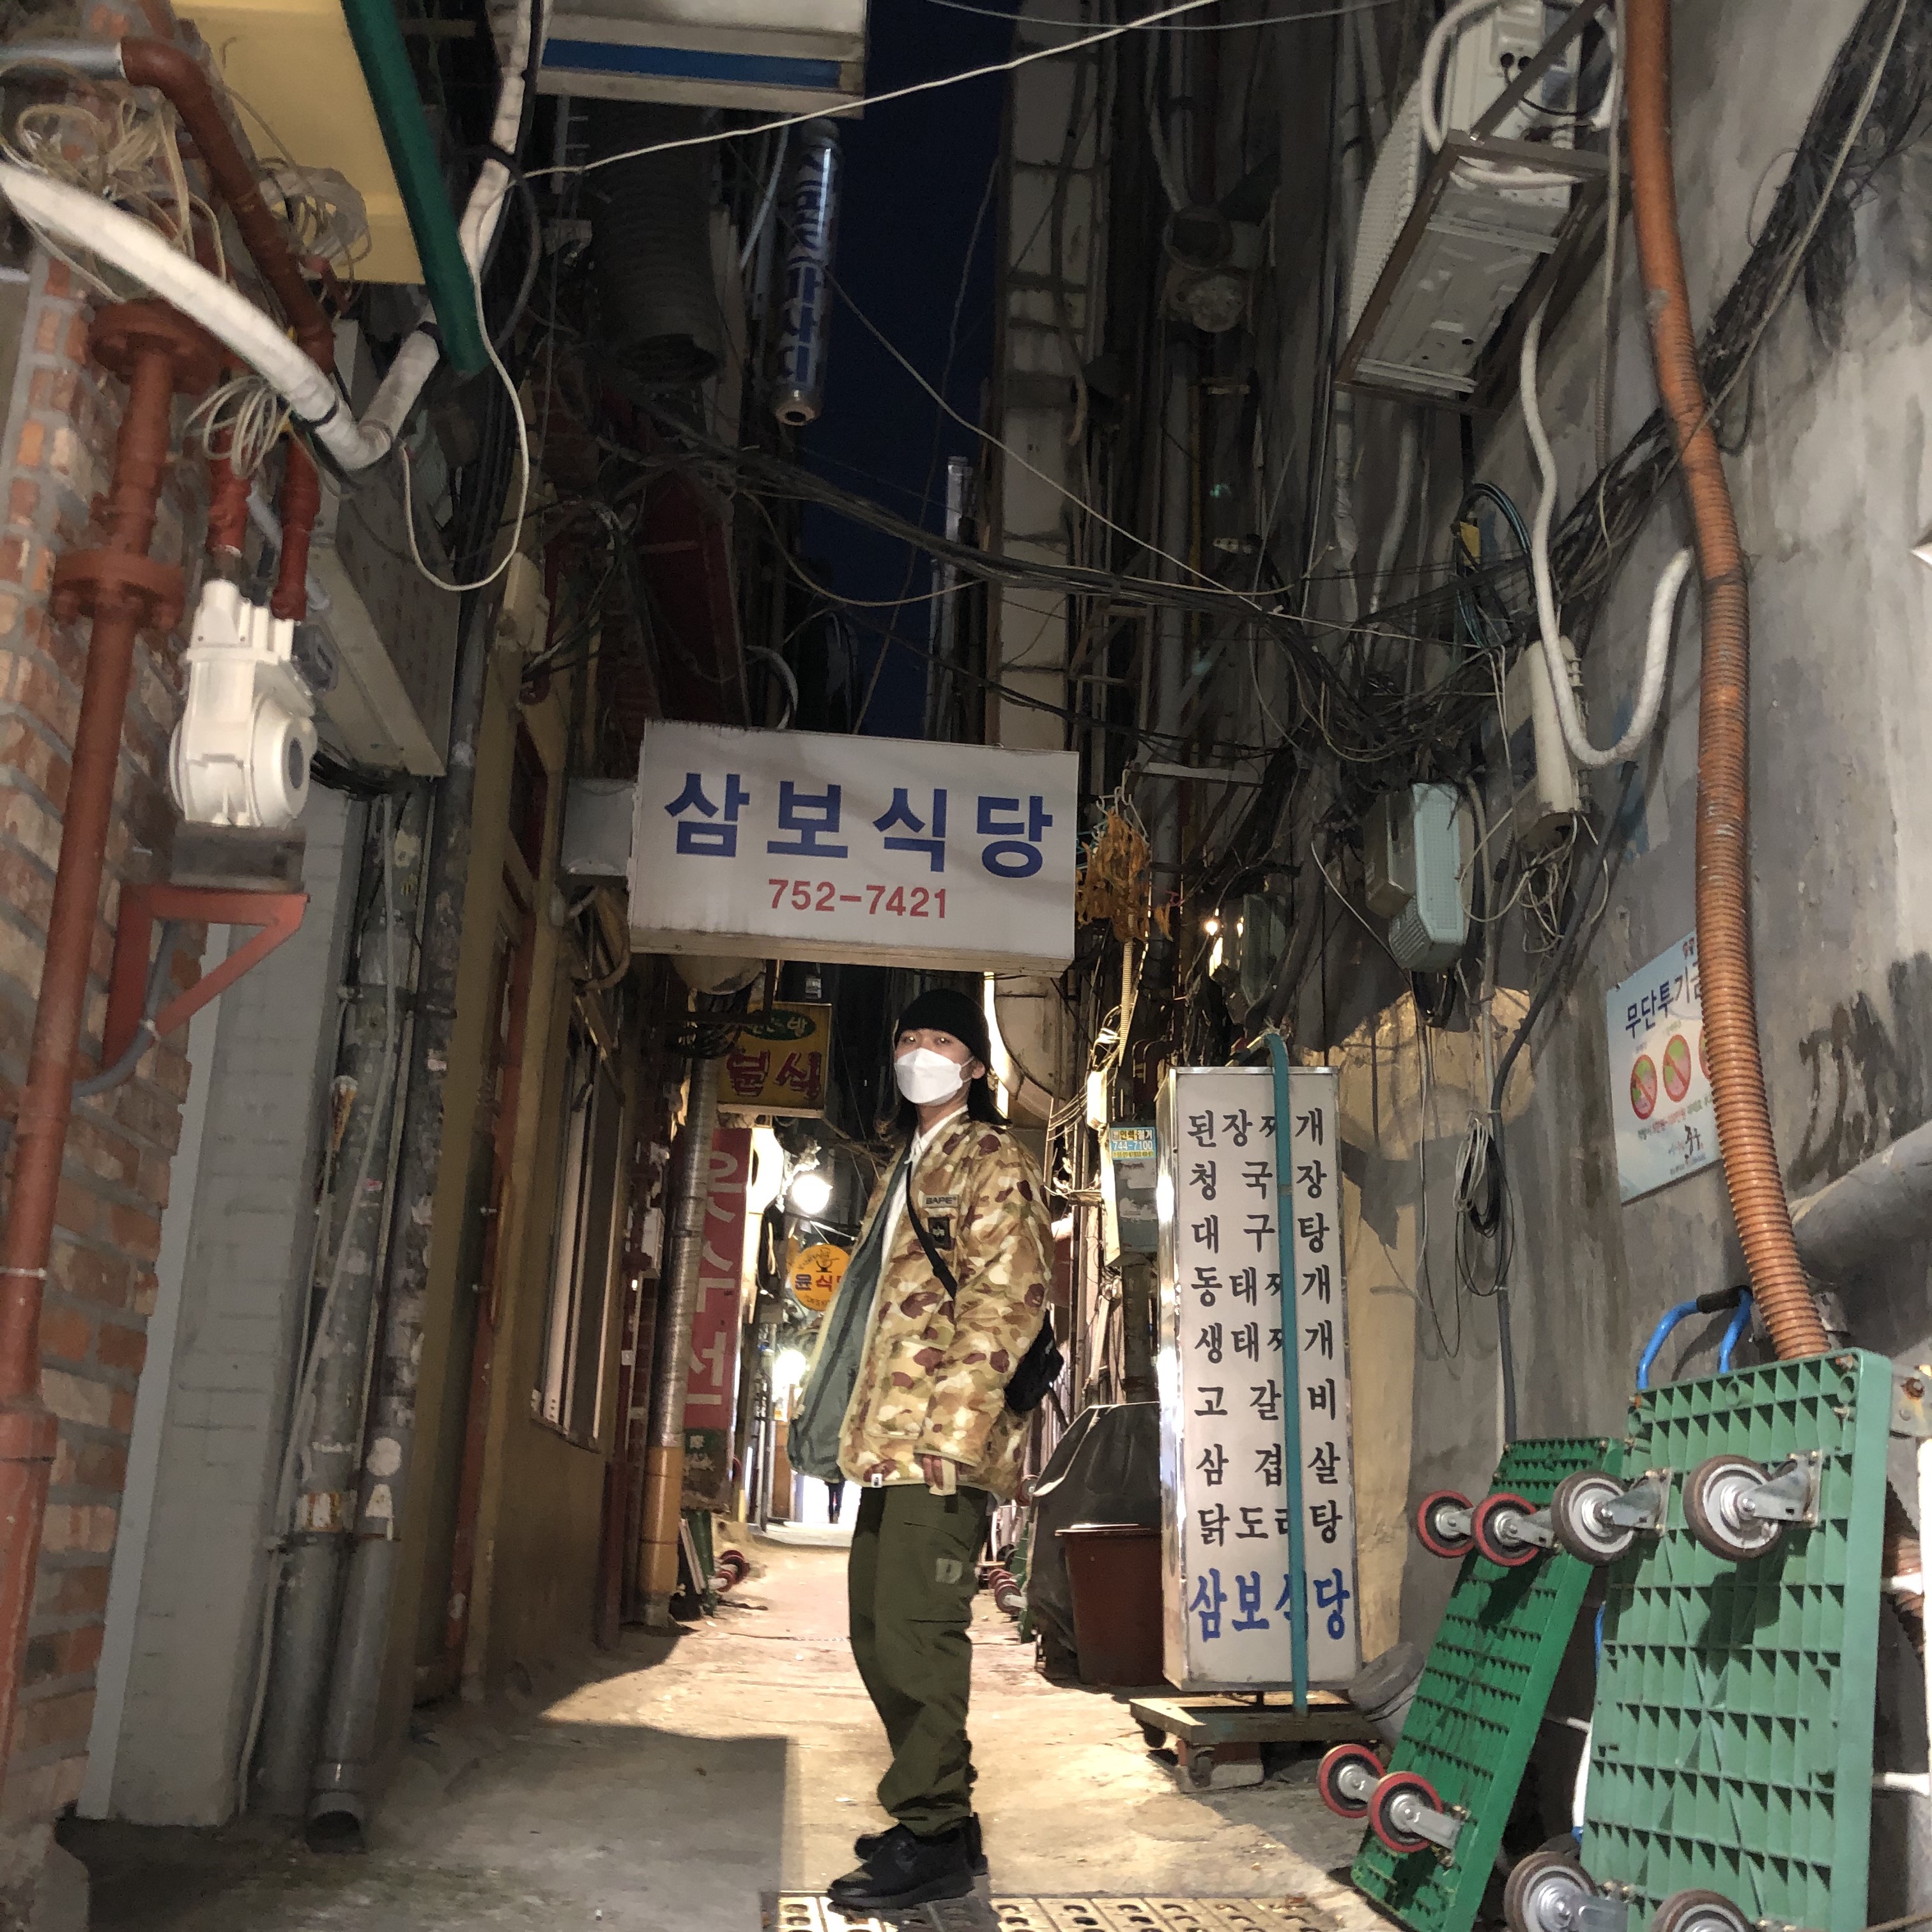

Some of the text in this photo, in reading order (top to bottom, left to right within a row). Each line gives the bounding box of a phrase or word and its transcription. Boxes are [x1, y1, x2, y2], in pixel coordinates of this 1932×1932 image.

[664, 772, 1054, 878] 삼보식당
[768, 878, 947, 919] 752-7421
[1113, 1140, 1153, 1151] 744-7100
[795, 1273, 842, 1292] 윤식
